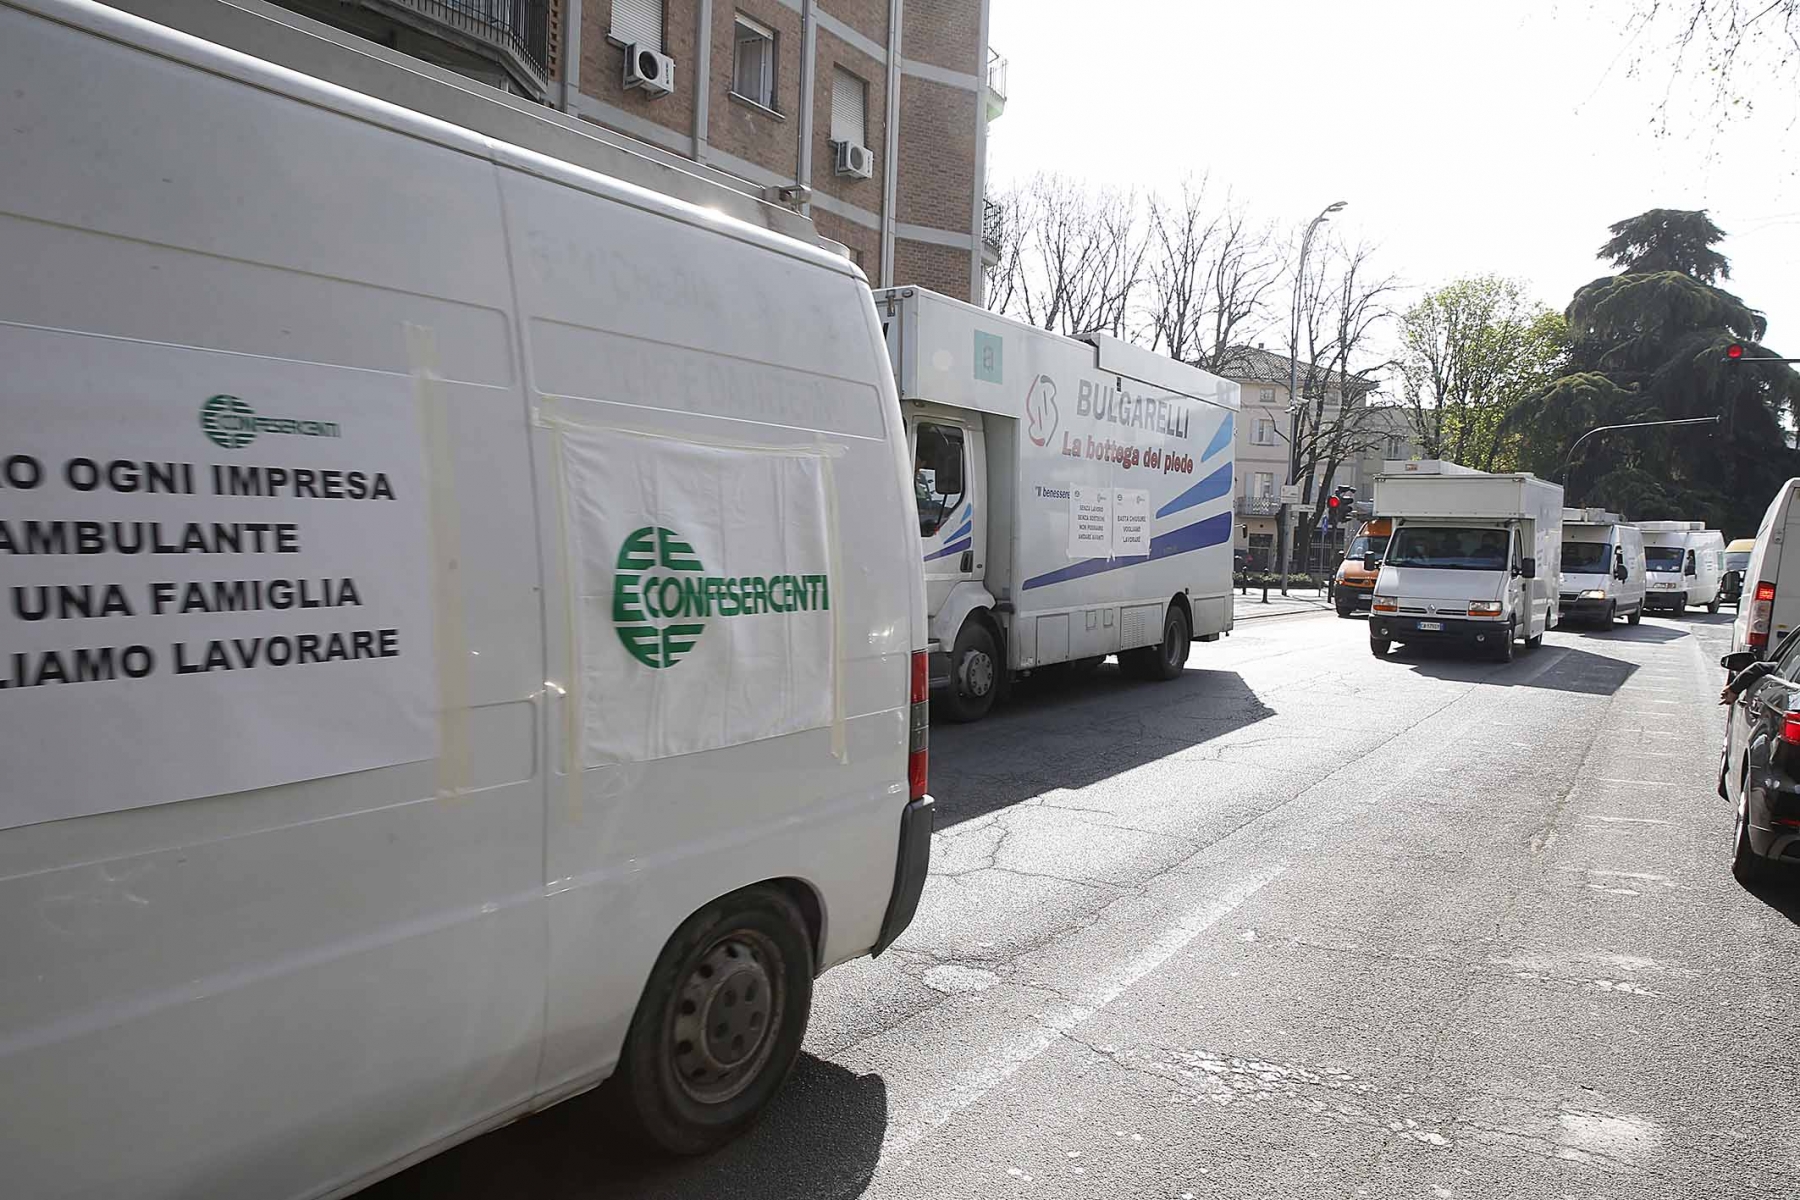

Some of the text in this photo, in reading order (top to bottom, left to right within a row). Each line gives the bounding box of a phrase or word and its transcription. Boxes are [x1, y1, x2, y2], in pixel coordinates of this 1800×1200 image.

[1076, 378, 1189, 439] BULGARELLI
[1062, 430, 1194, 475] La bottega del piede
[64, 457, 197, 495] OGNI
[210, 464, 398, 501] IMPRESA
[0, 520, 300, 554] AMBULANTE
[9, 578, 363, 621] UNA FAMIGLIA
[642, 574, 830, 619] CONFESERCENTI
[172, 628, 400, 674] LAVORARE
